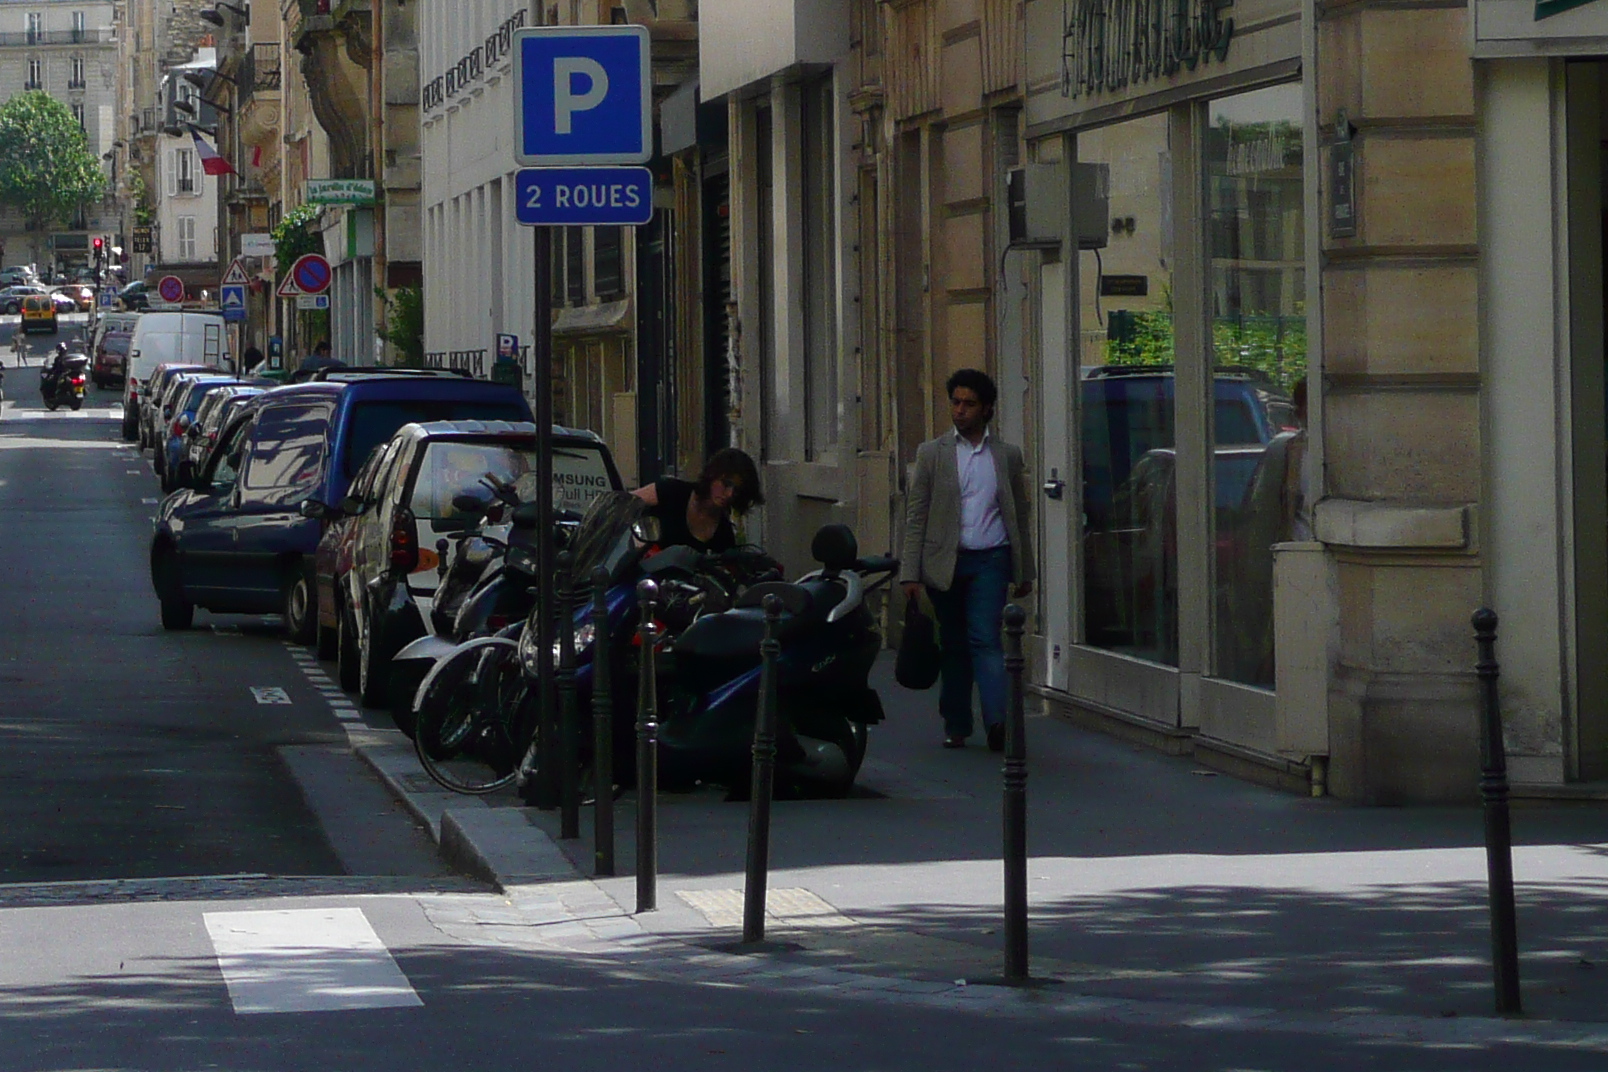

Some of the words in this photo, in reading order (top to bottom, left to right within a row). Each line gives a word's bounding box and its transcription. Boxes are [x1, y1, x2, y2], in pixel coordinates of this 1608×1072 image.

[553, 57, 609, 134] P
[526, 185, 541, 208] 2
[556, 184, 640, 208] ROUES
[553, 473, 606, 487] MSUNG
